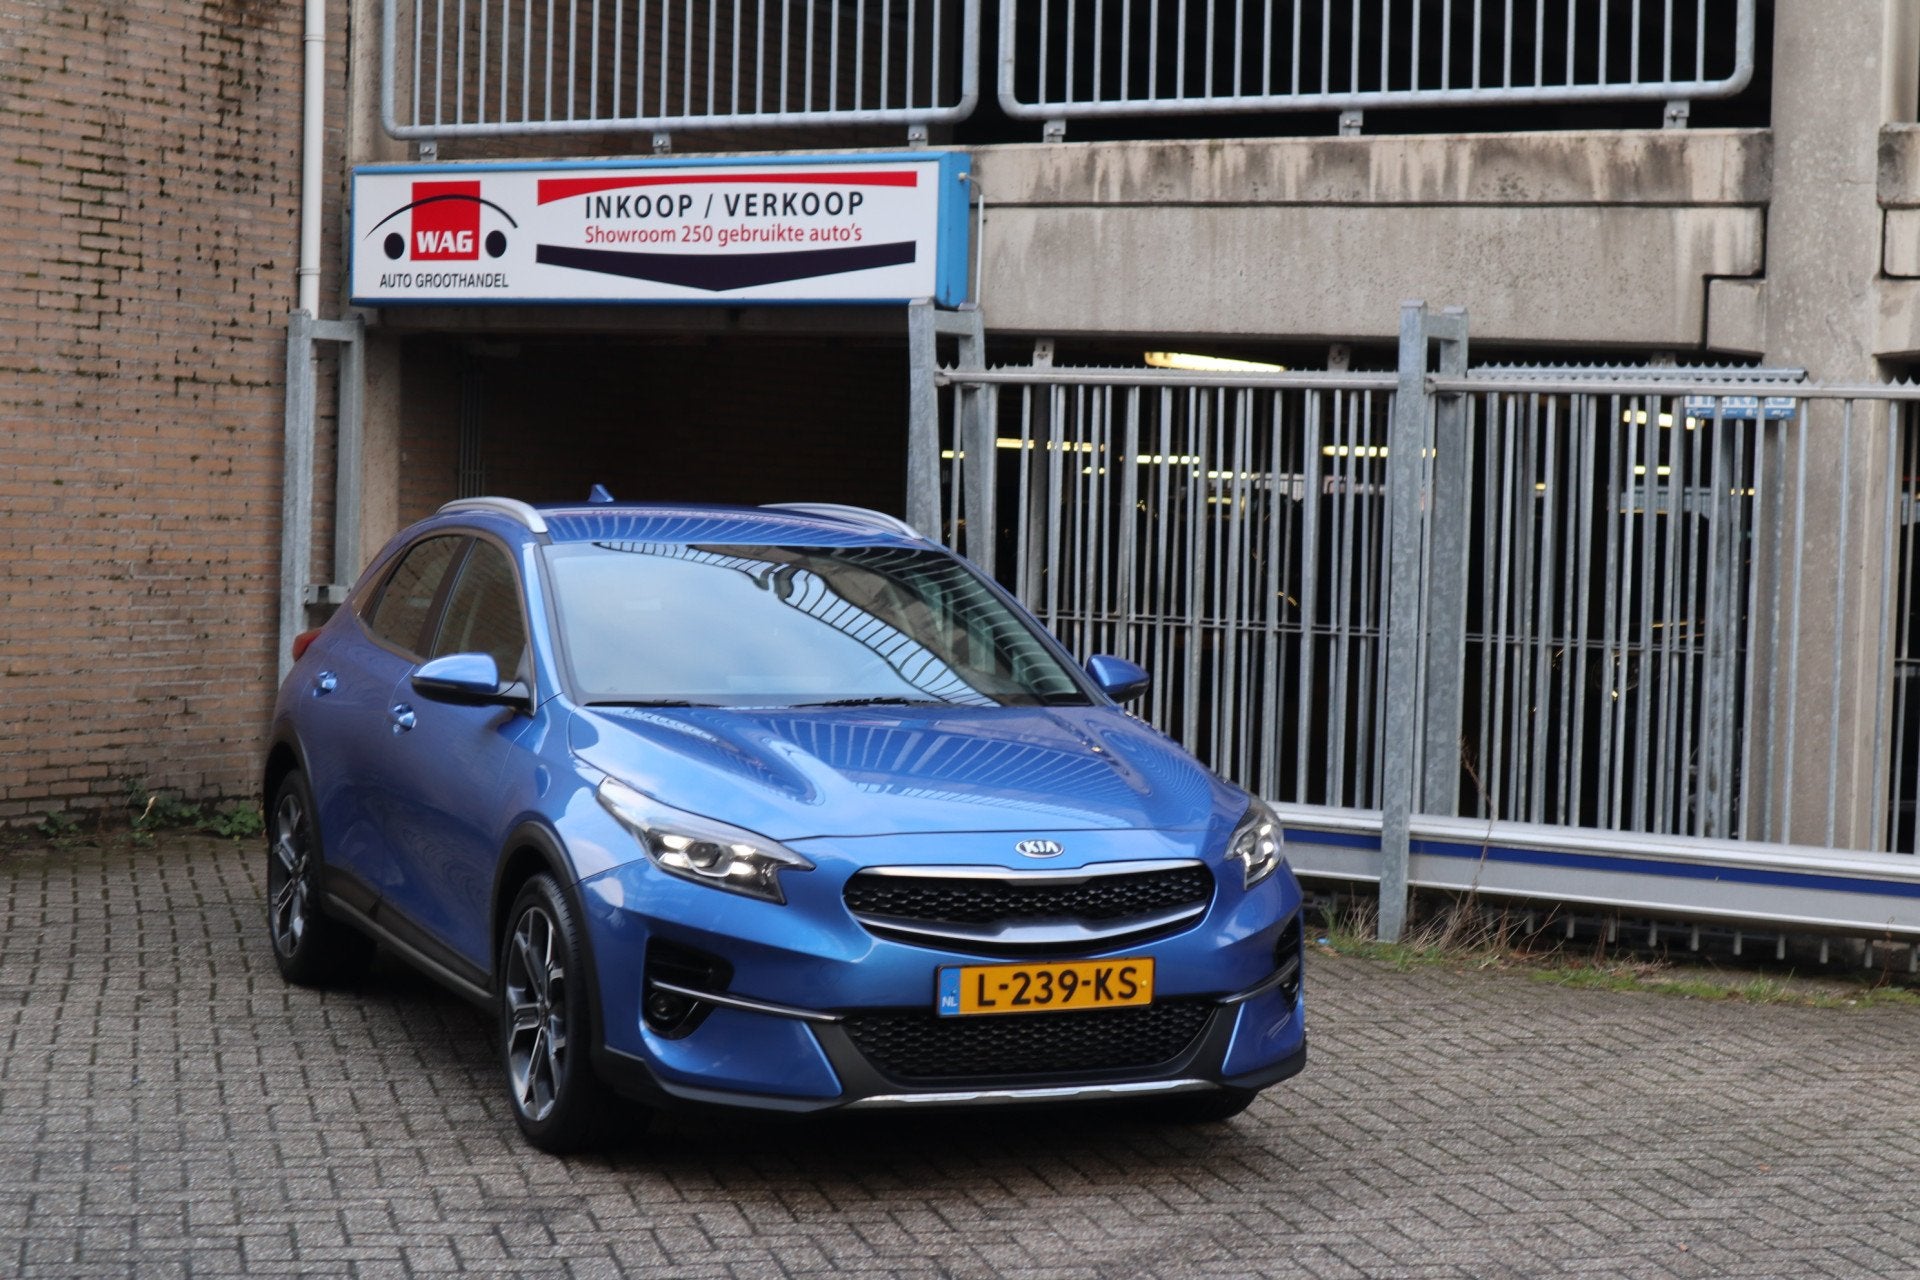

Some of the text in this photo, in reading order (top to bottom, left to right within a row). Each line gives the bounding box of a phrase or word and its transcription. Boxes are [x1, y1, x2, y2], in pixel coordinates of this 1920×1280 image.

[585, 191, 864, 218] INKOOP / VERKOOP
[416, 231, 474, 253] WAG
[585, 226, 676, 243] Showroom
[681, 226, 713, 243] 250
[717, 224, 804, 246] gebruikte
[379, 273, 509, 289] AUTO GROOTHANDEL
[1024, 840, 1058, 853] KIA
[978, 967, 1138, 1006] L-239-KS
[942, 996, 957, 1007] NL
